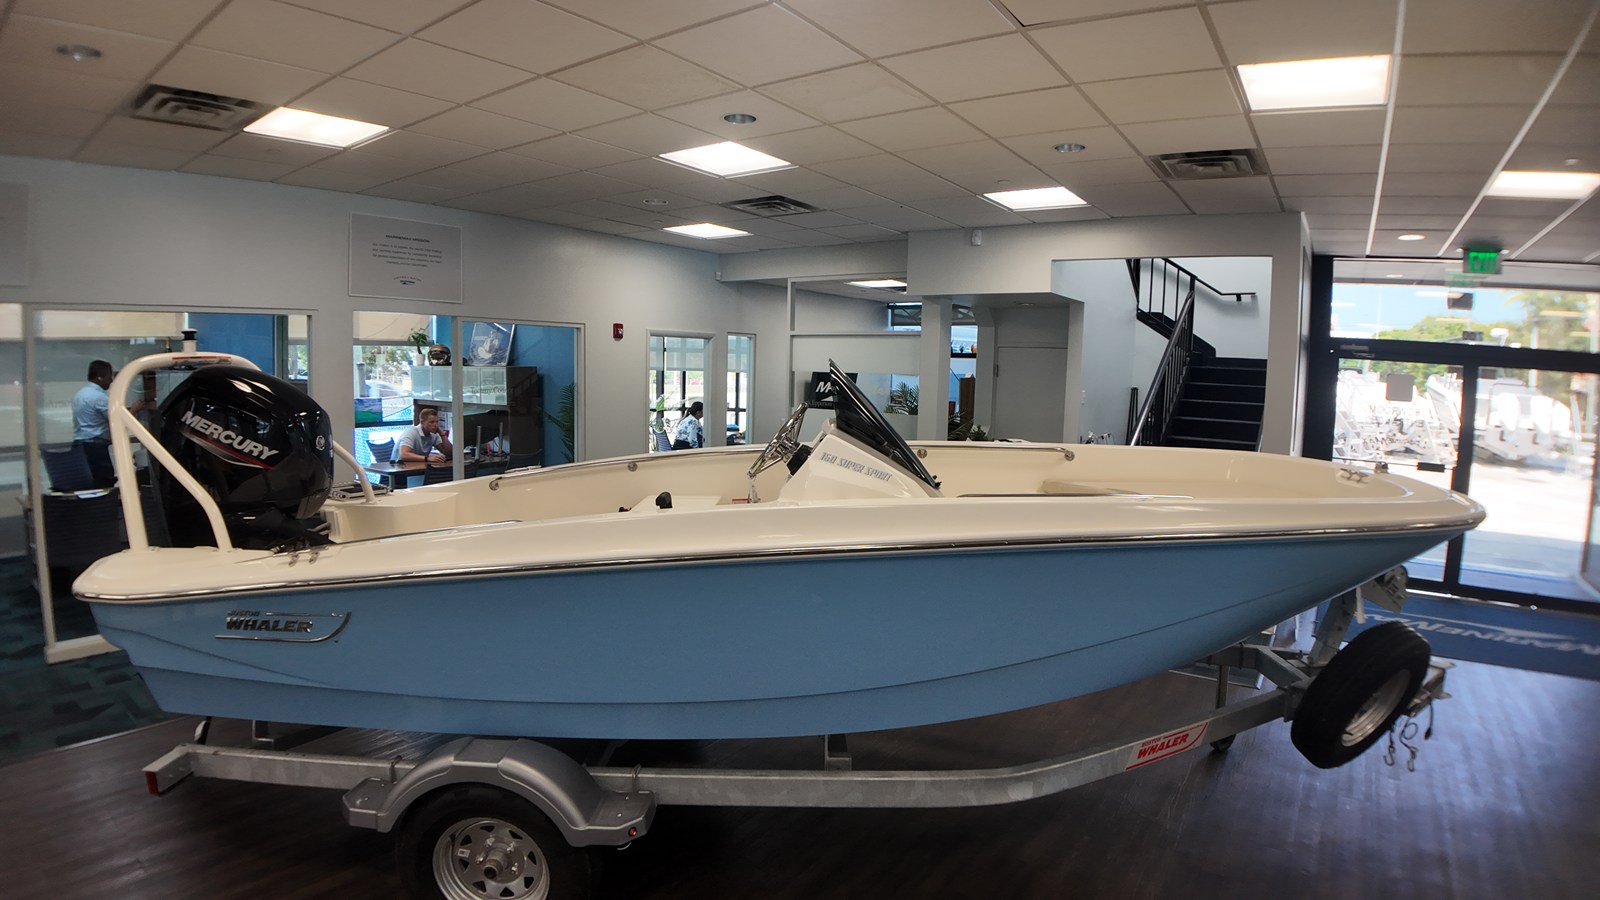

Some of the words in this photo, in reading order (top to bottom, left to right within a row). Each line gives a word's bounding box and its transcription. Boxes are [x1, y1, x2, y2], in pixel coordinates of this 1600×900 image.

[1469, 251, 1497, 273] EXIT
[181, 410, 279, 461] MERCURY
[821, 452, 838, 464] 160
[837, 458, 866, 474] SUPER
[864, 467, 893, 482] SPORT
[226, 617, 313, 633] WHALER
[1137, 733, 1189, 759] WHALER
